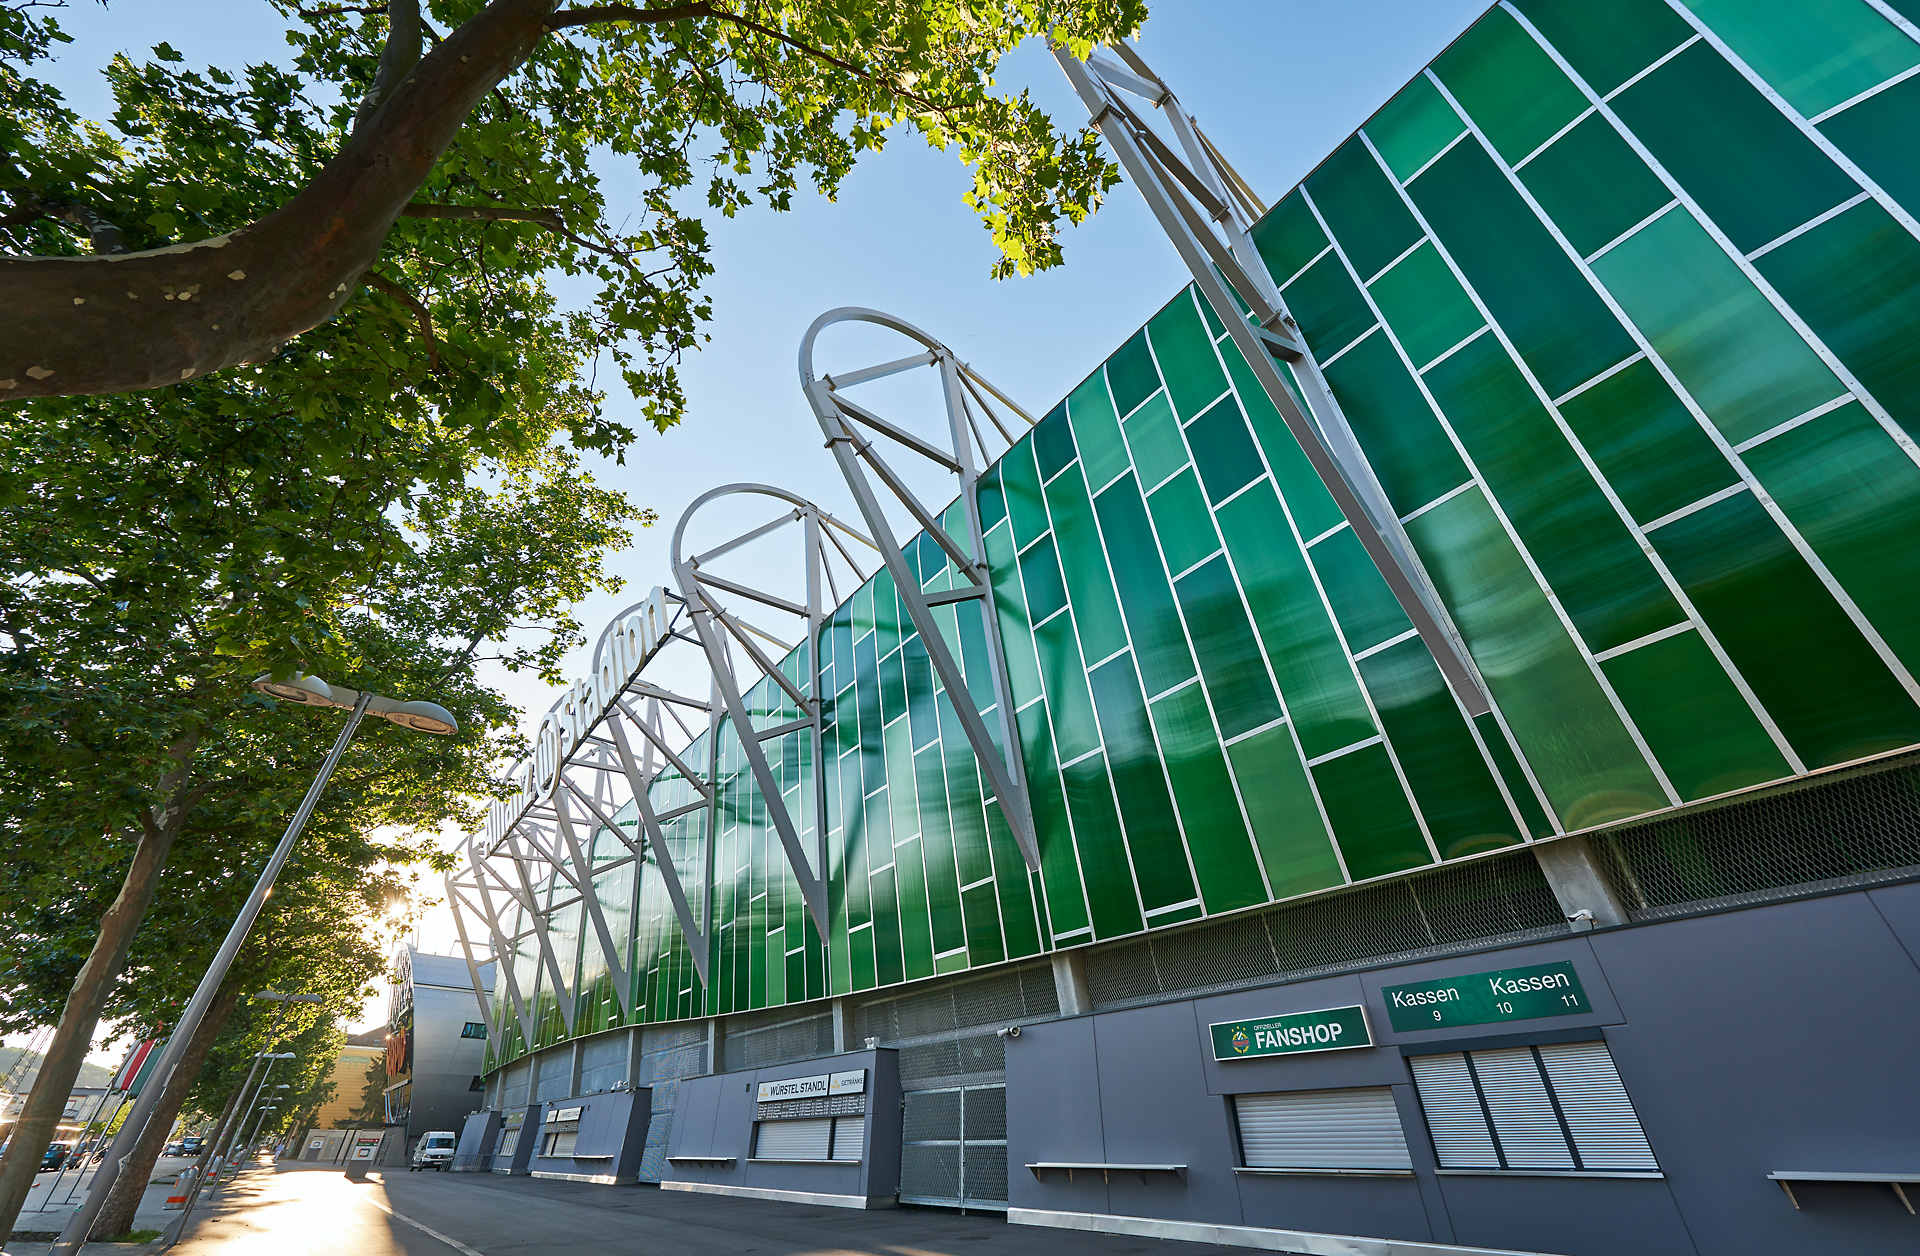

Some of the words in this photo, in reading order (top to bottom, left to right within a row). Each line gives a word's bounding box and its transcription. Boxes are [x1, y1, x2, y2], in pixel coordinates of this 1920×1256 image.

[1391, 987, 1460, 1008] Kassen
[1489, 972, 1570, 996] Kassen
[1432, 1010, 1442, 1022] 9
[1496, 1001, 1513, 1014] 10
[1561, 994, 1579, 1007] 11
[1253, 1022, 1282, 1031] OFFIZIELLER
[1255, 1023, 1343, 1049] FANSHOP
[770, 1083, 799, 1097] WÜRSTEL
[800, 1080, 826, 1093] STANDL
[841, 1077, 864, 1087] GETRÄNKE
